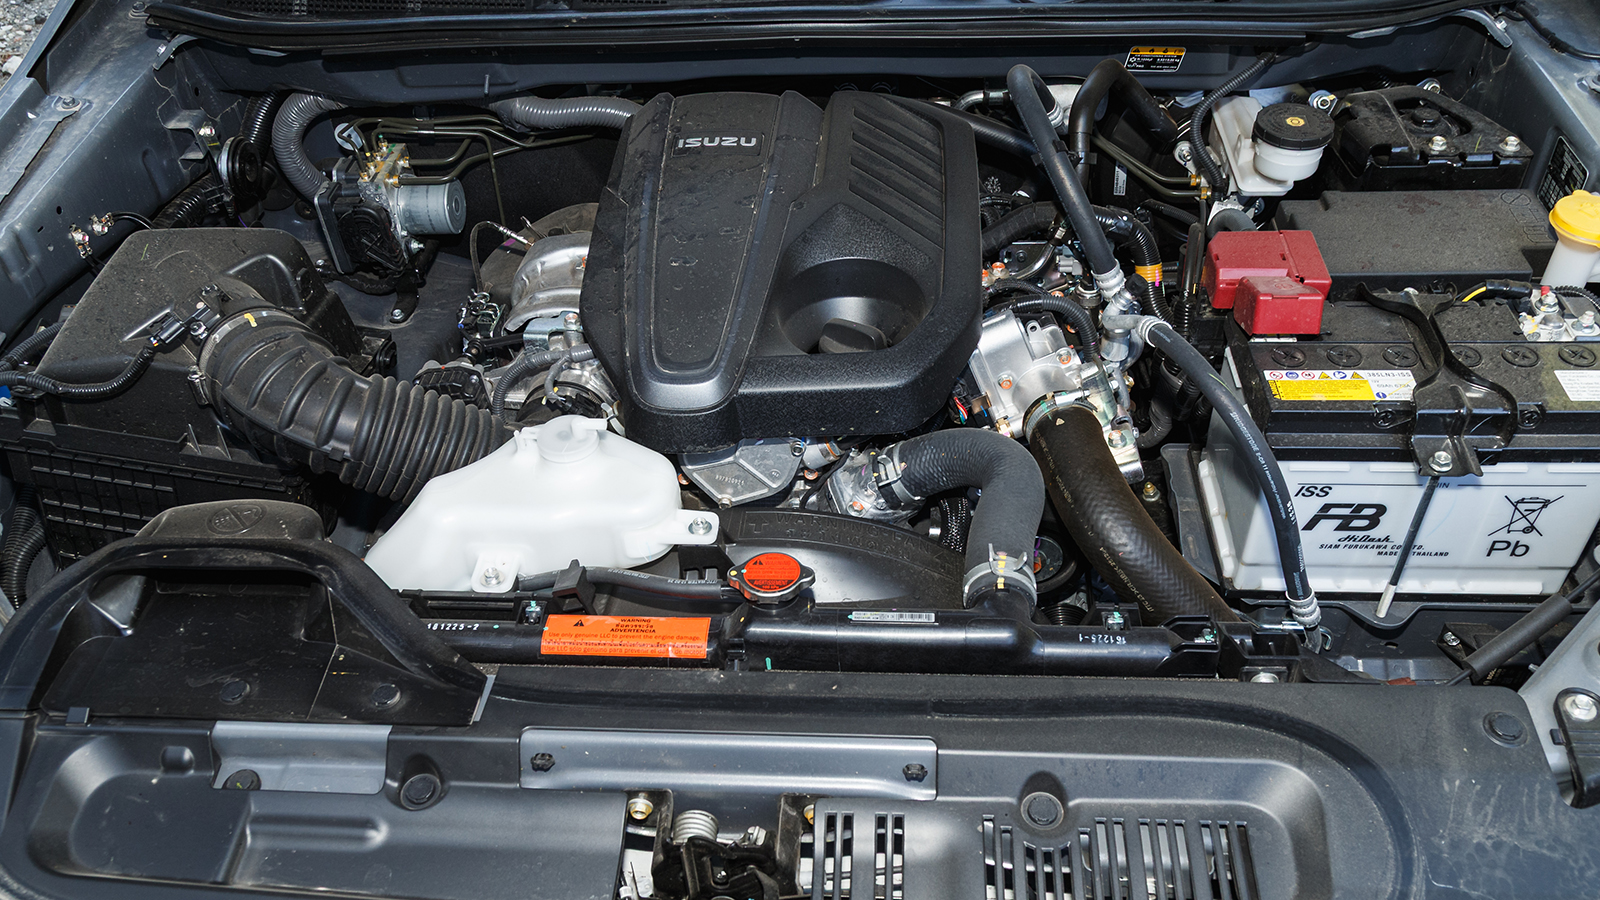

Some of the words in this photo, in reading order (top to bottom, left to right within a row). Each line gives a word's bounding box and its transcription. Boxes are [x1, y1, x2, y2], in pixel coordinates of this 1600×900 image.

[678, 136, 757, 148] ISUZU
[1294, 486, 1333, 498] ISS
[1301, 503, 1388, 531] FB
[1486, 541, 1530, 557] Pb
[427, 623, 480, 631] 181225-2
